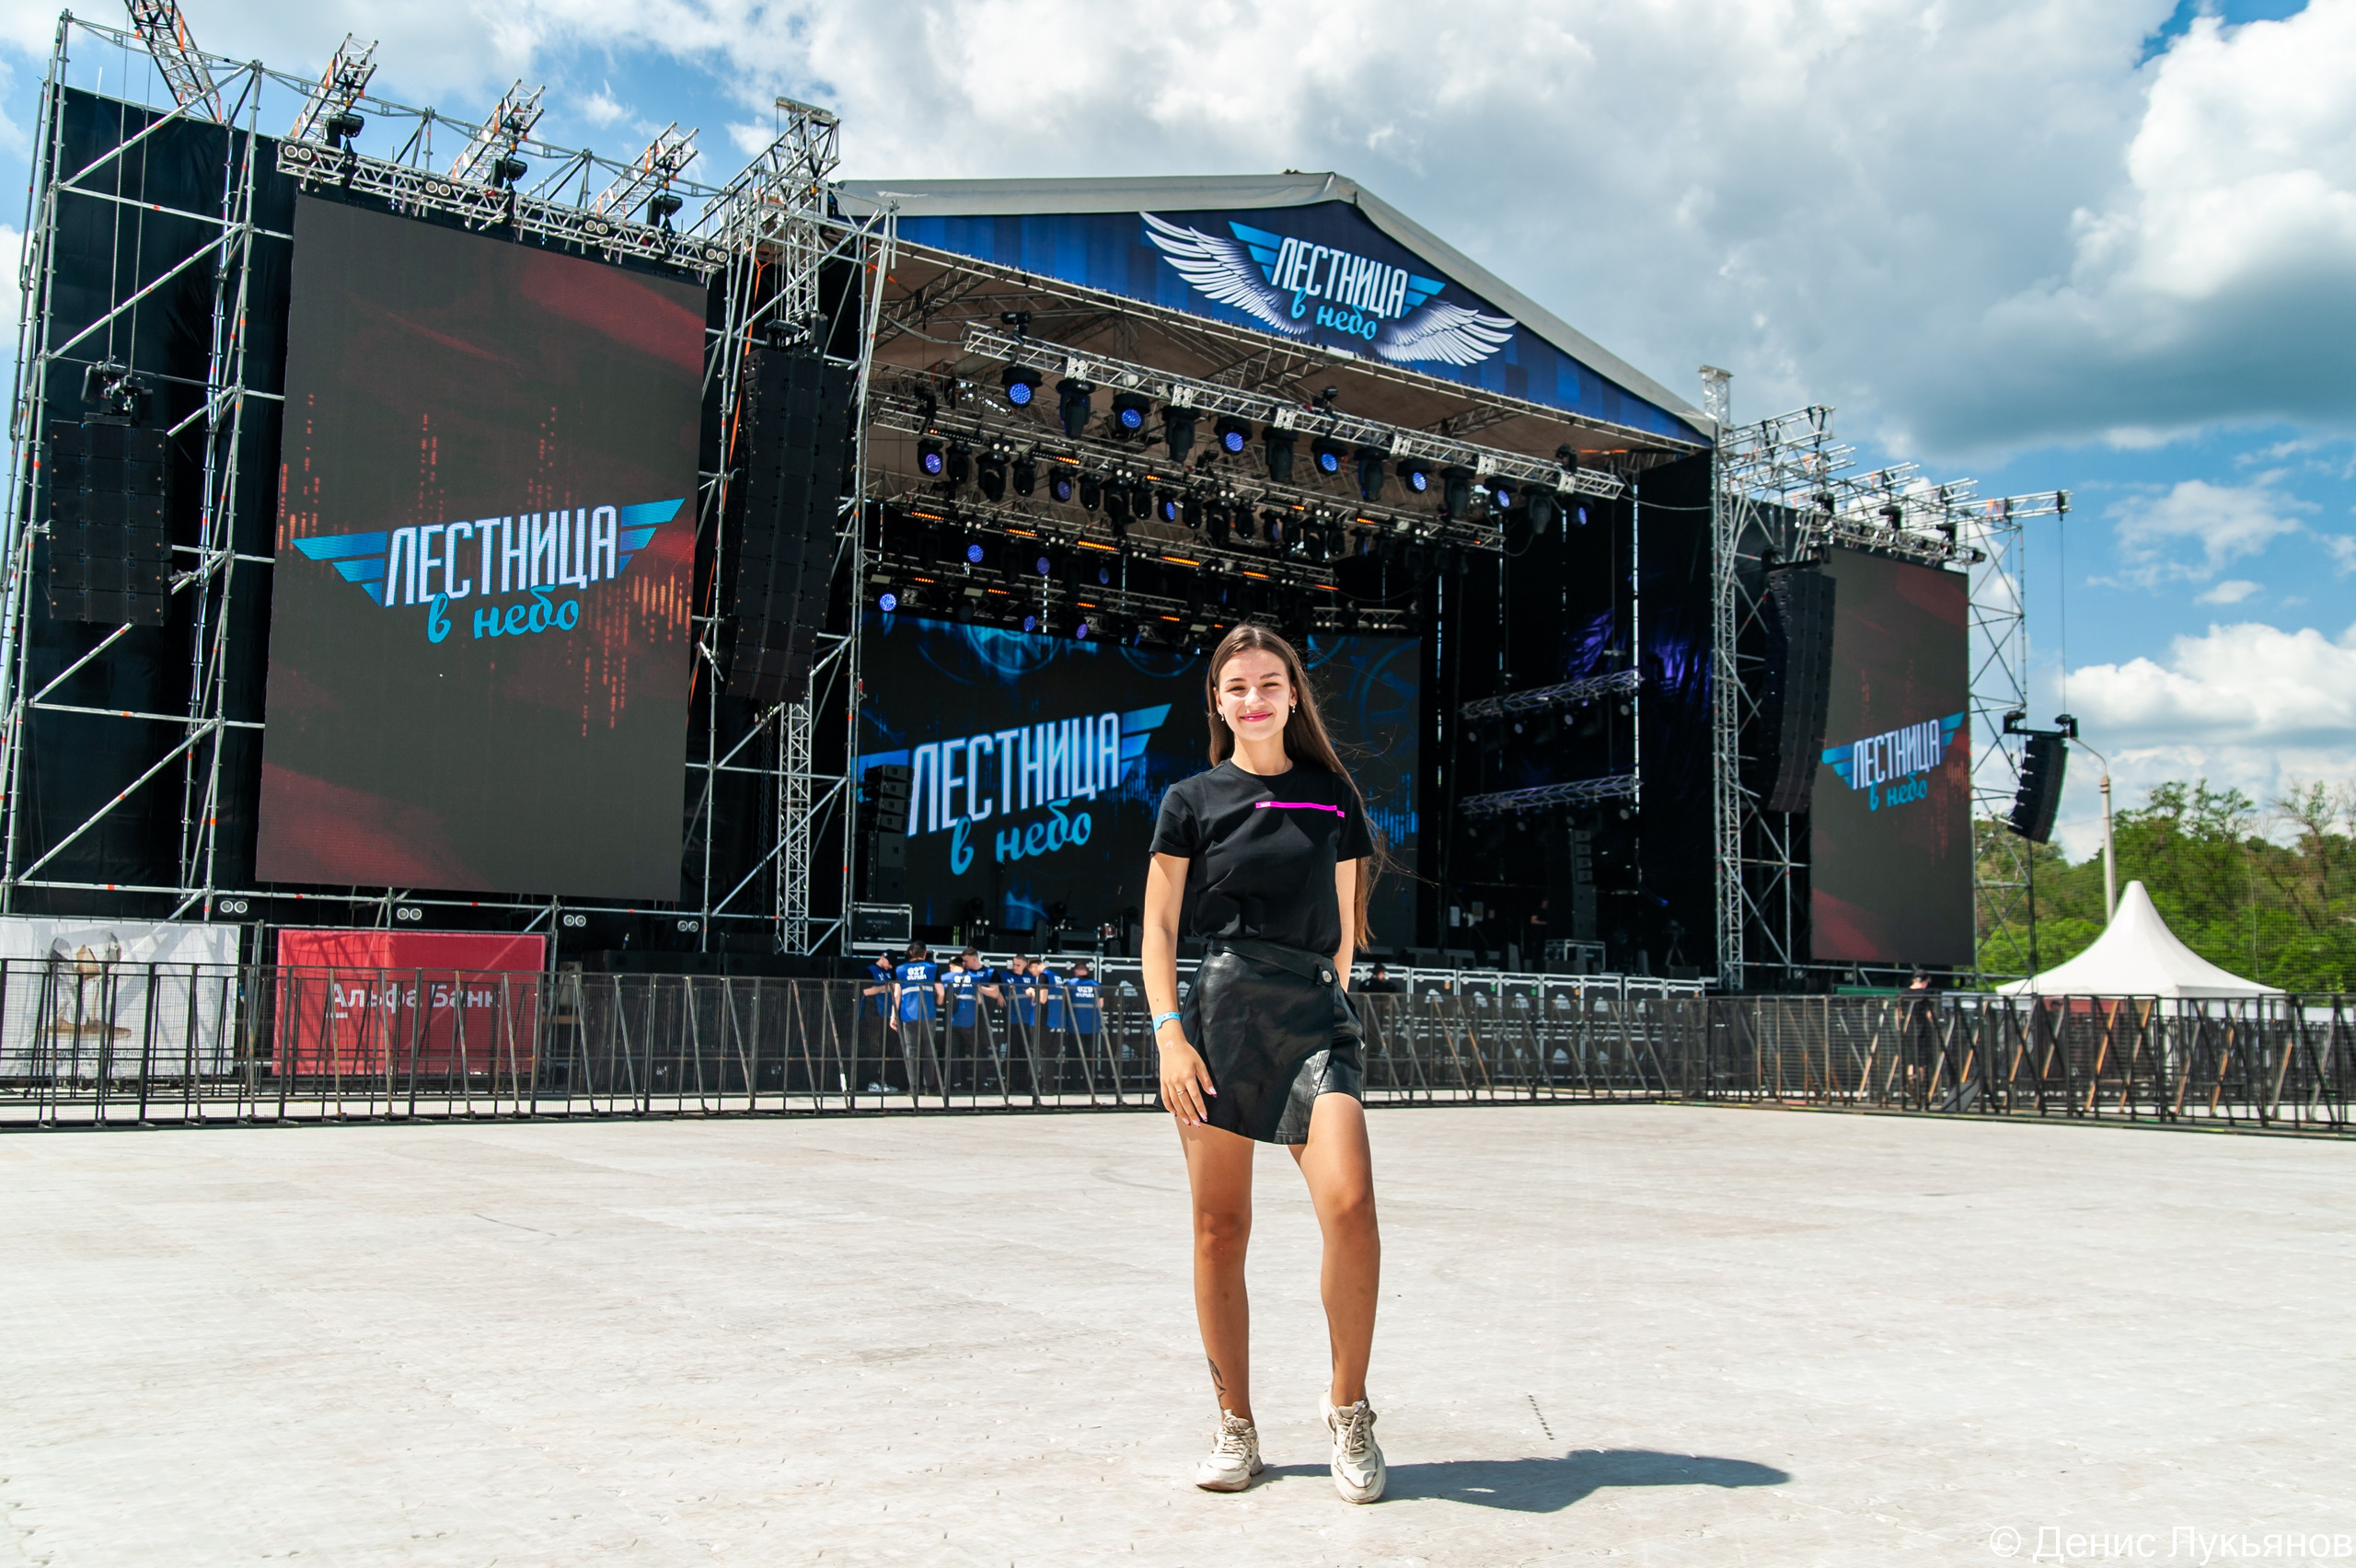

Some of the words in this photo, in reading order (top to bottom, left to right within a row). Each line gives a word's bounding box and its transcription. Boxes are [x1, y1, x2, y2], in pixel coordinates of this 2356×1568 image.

[1271, 236, 1409, 318] ЛЕСТНИЦА
[1291, 288, 1306, 319] в
[1316, 305, 1377, 340] небо
[385, 505, 618, 607] ЛЕСТНИЦА
[427, 593, 452, 643] в
[474, 585, 579, 639] небо
[907, 712, 1119, 836] ЛЕСТНИЦА
[1853, 719, 1940, 790] ЛЕСТНИЦА
[1869, 779, 1880, 812] в
[1886, 771, 1928, 807] небо
[951, 817, 975, 875] в
[996, 799, 1091, 863] небо
[328, 983, 422, 1018] Альфа
[431, 985, 500, 1008] Банк
